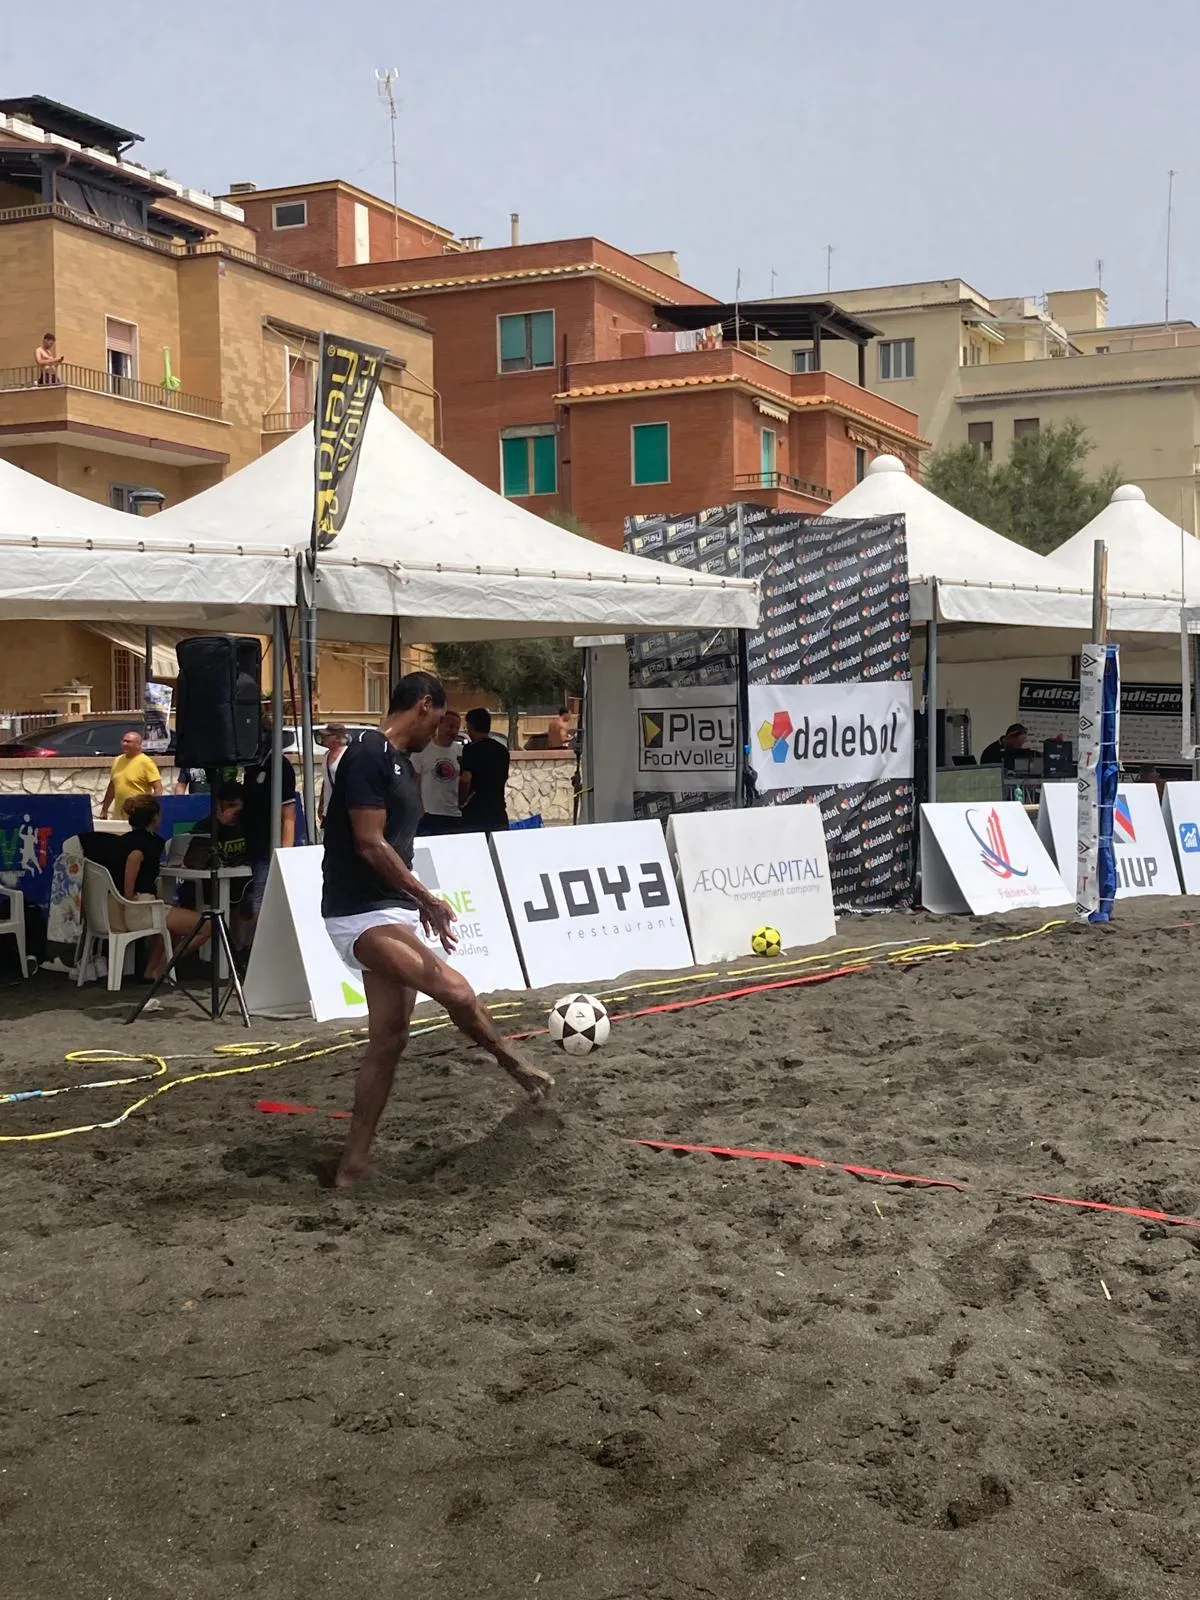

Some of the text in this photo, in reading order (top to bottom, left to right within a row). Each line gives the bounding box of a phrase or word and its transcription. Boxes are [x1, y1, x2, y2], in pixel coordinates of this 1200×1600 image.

[643, 531, 661, 543] Play
[669, 713, 735, 748] Play
[793, 712, 897, 760] dalebol
[644, 749, 735, 769] FootVolley
[693, 858, 824, 897] ÆQUACAPITAL
[734, 884, 820, 901] management company
[567, 916, 675, 940] restaurant
